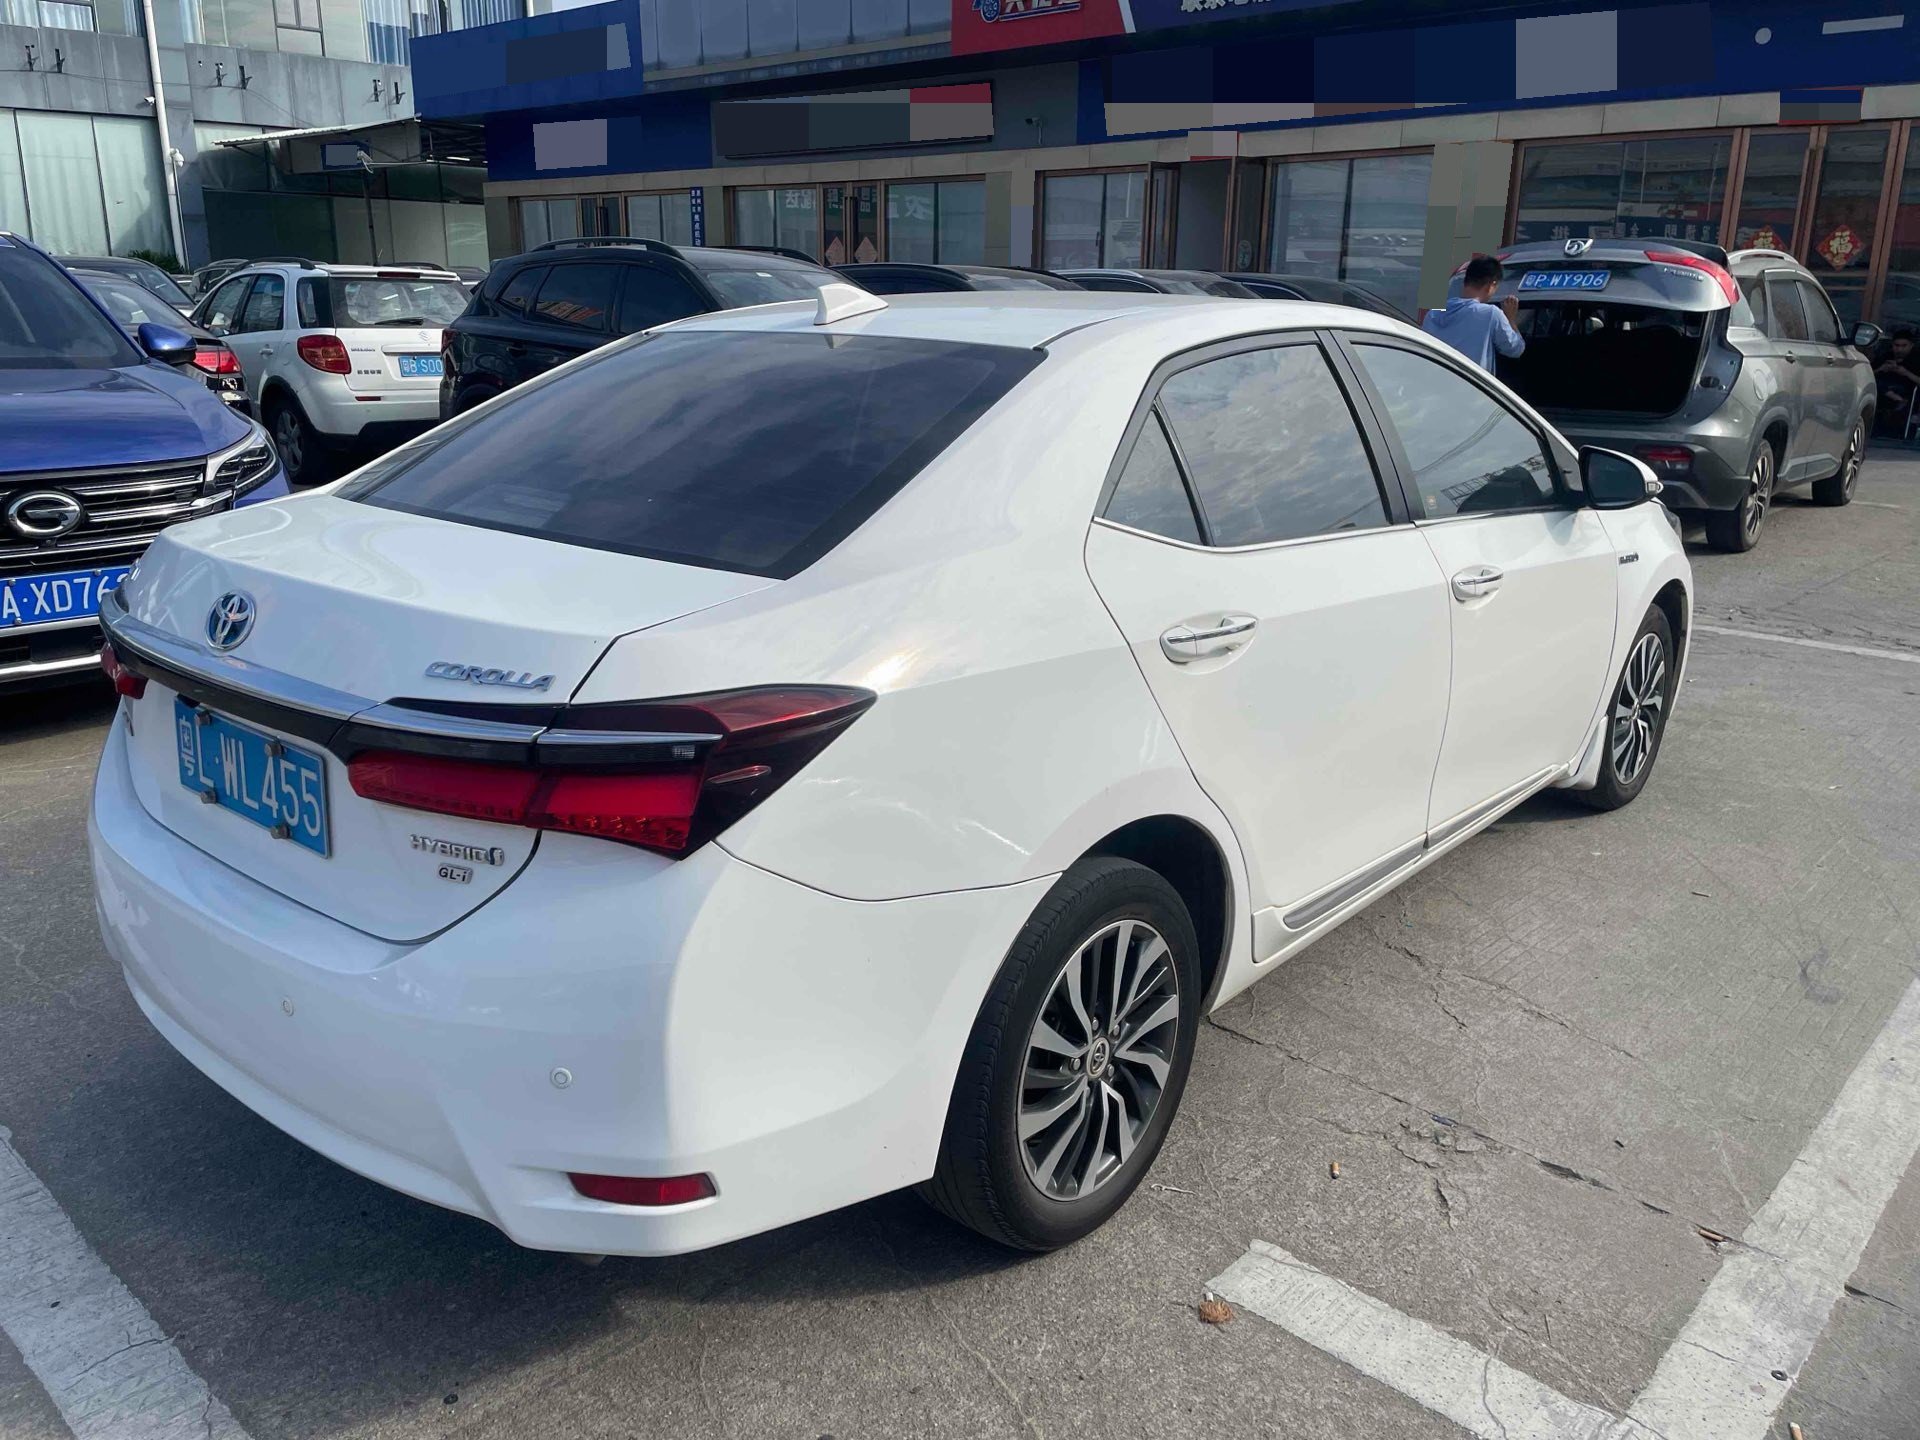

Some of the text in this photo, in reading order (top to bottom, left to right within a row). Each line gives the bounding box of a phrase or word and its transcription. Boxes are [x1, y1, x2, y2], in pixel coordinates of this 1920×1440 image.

[1829, 231, 1853, 254] 福
[424, 661, 557, 692] COROLLA
[410, 834, 490, 864] HYBRID
[438, 867, 468, 882] GL-i
